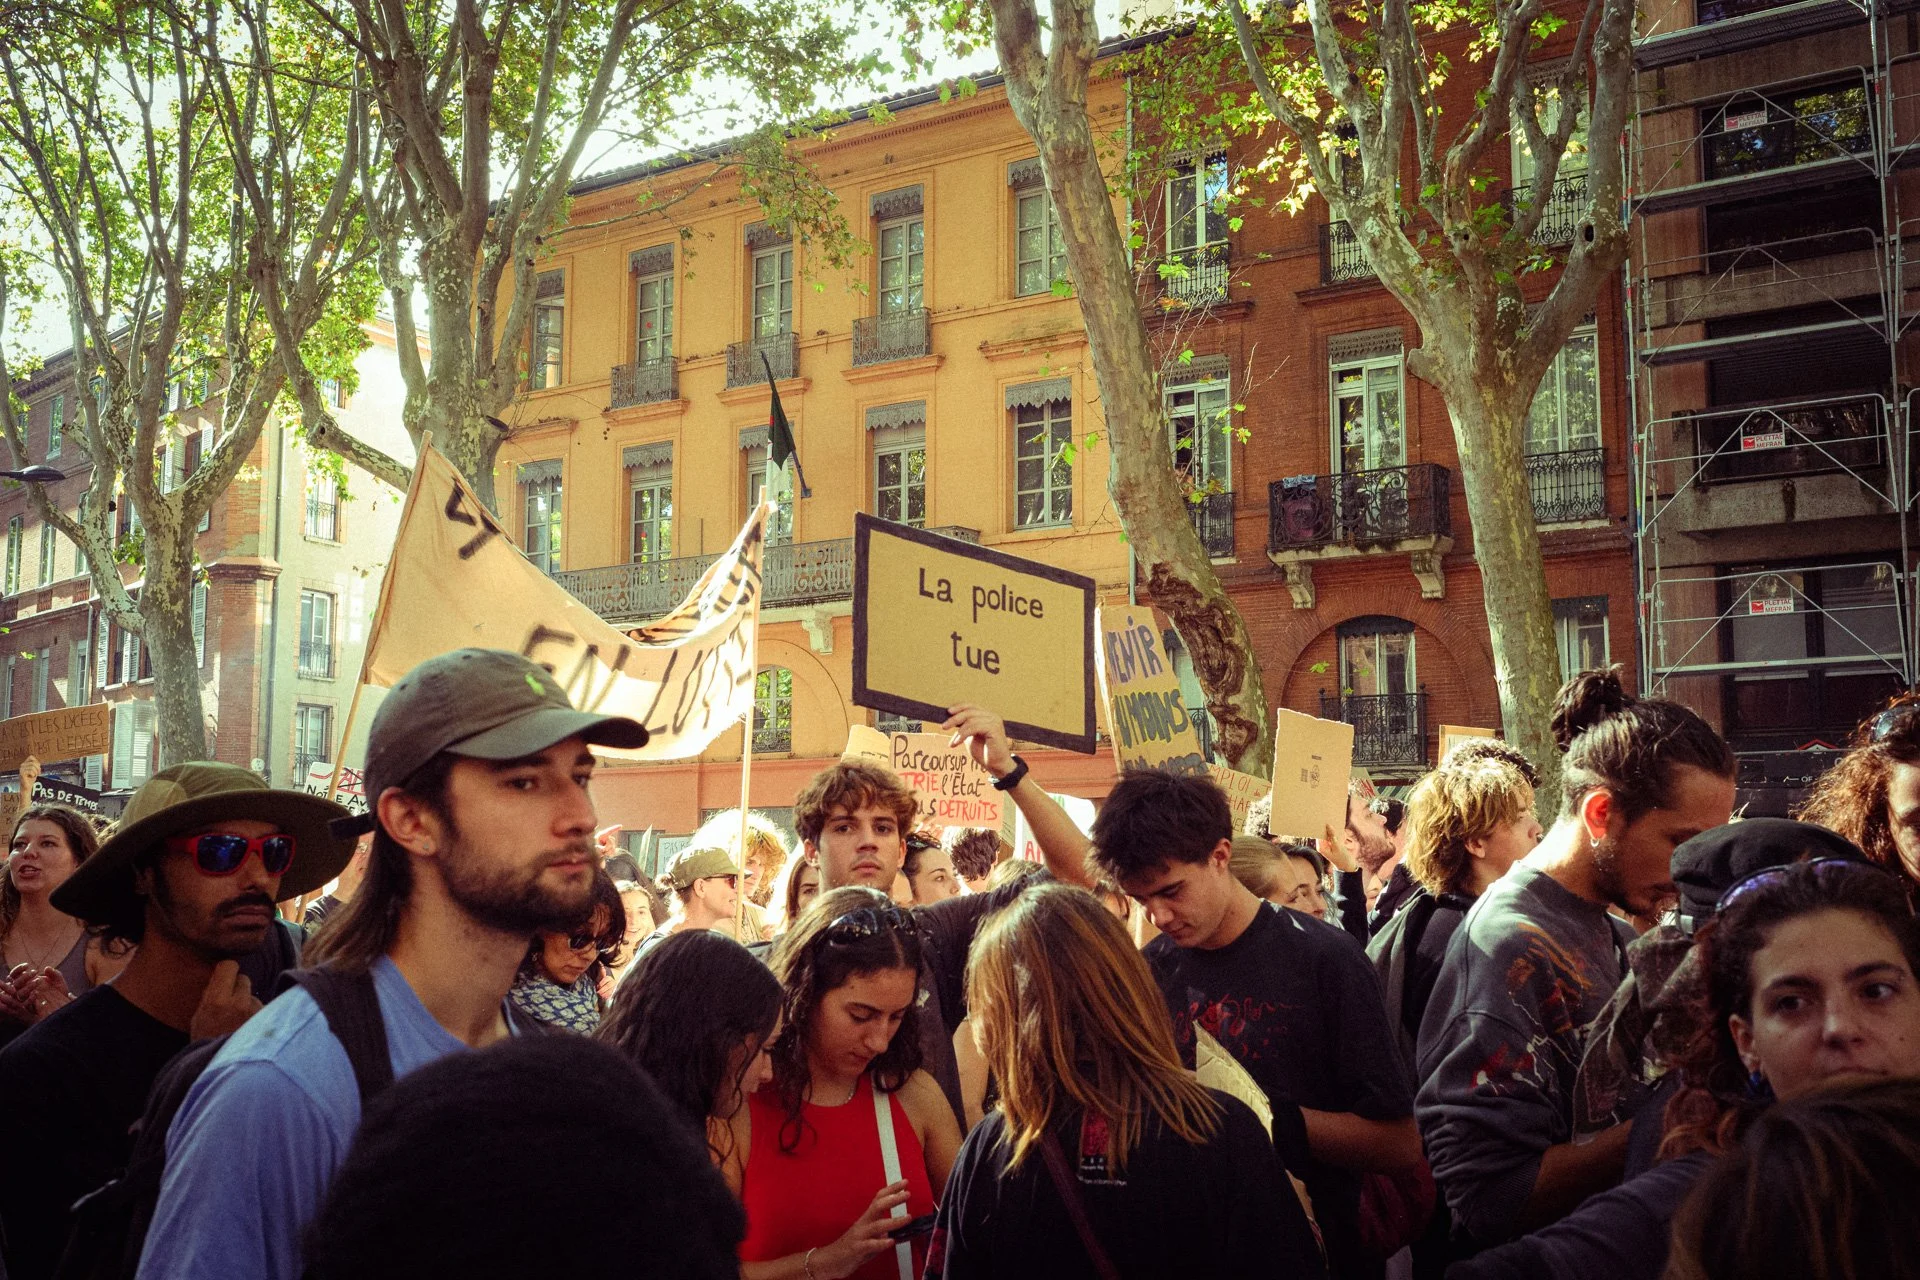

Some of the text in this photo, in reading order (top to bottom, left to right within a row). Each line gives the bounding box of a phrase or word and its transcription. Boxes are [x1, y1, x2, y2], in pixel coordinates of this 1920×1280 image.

[1756, 433, 1783, 442] PLETTAC
[918, 568, 1044, 623] La police
[1765, 598, 1792, 606] PLETTAC
[950, 631, 1000, 675] tue
[39, 716, 60, 734] LES
[64, 709, 103, 729] LYCÉES
[893, 735, 967, 772] Parcoursup
[32, 781, 54, 799] PAS
[57, 790, 73, 802] DE
